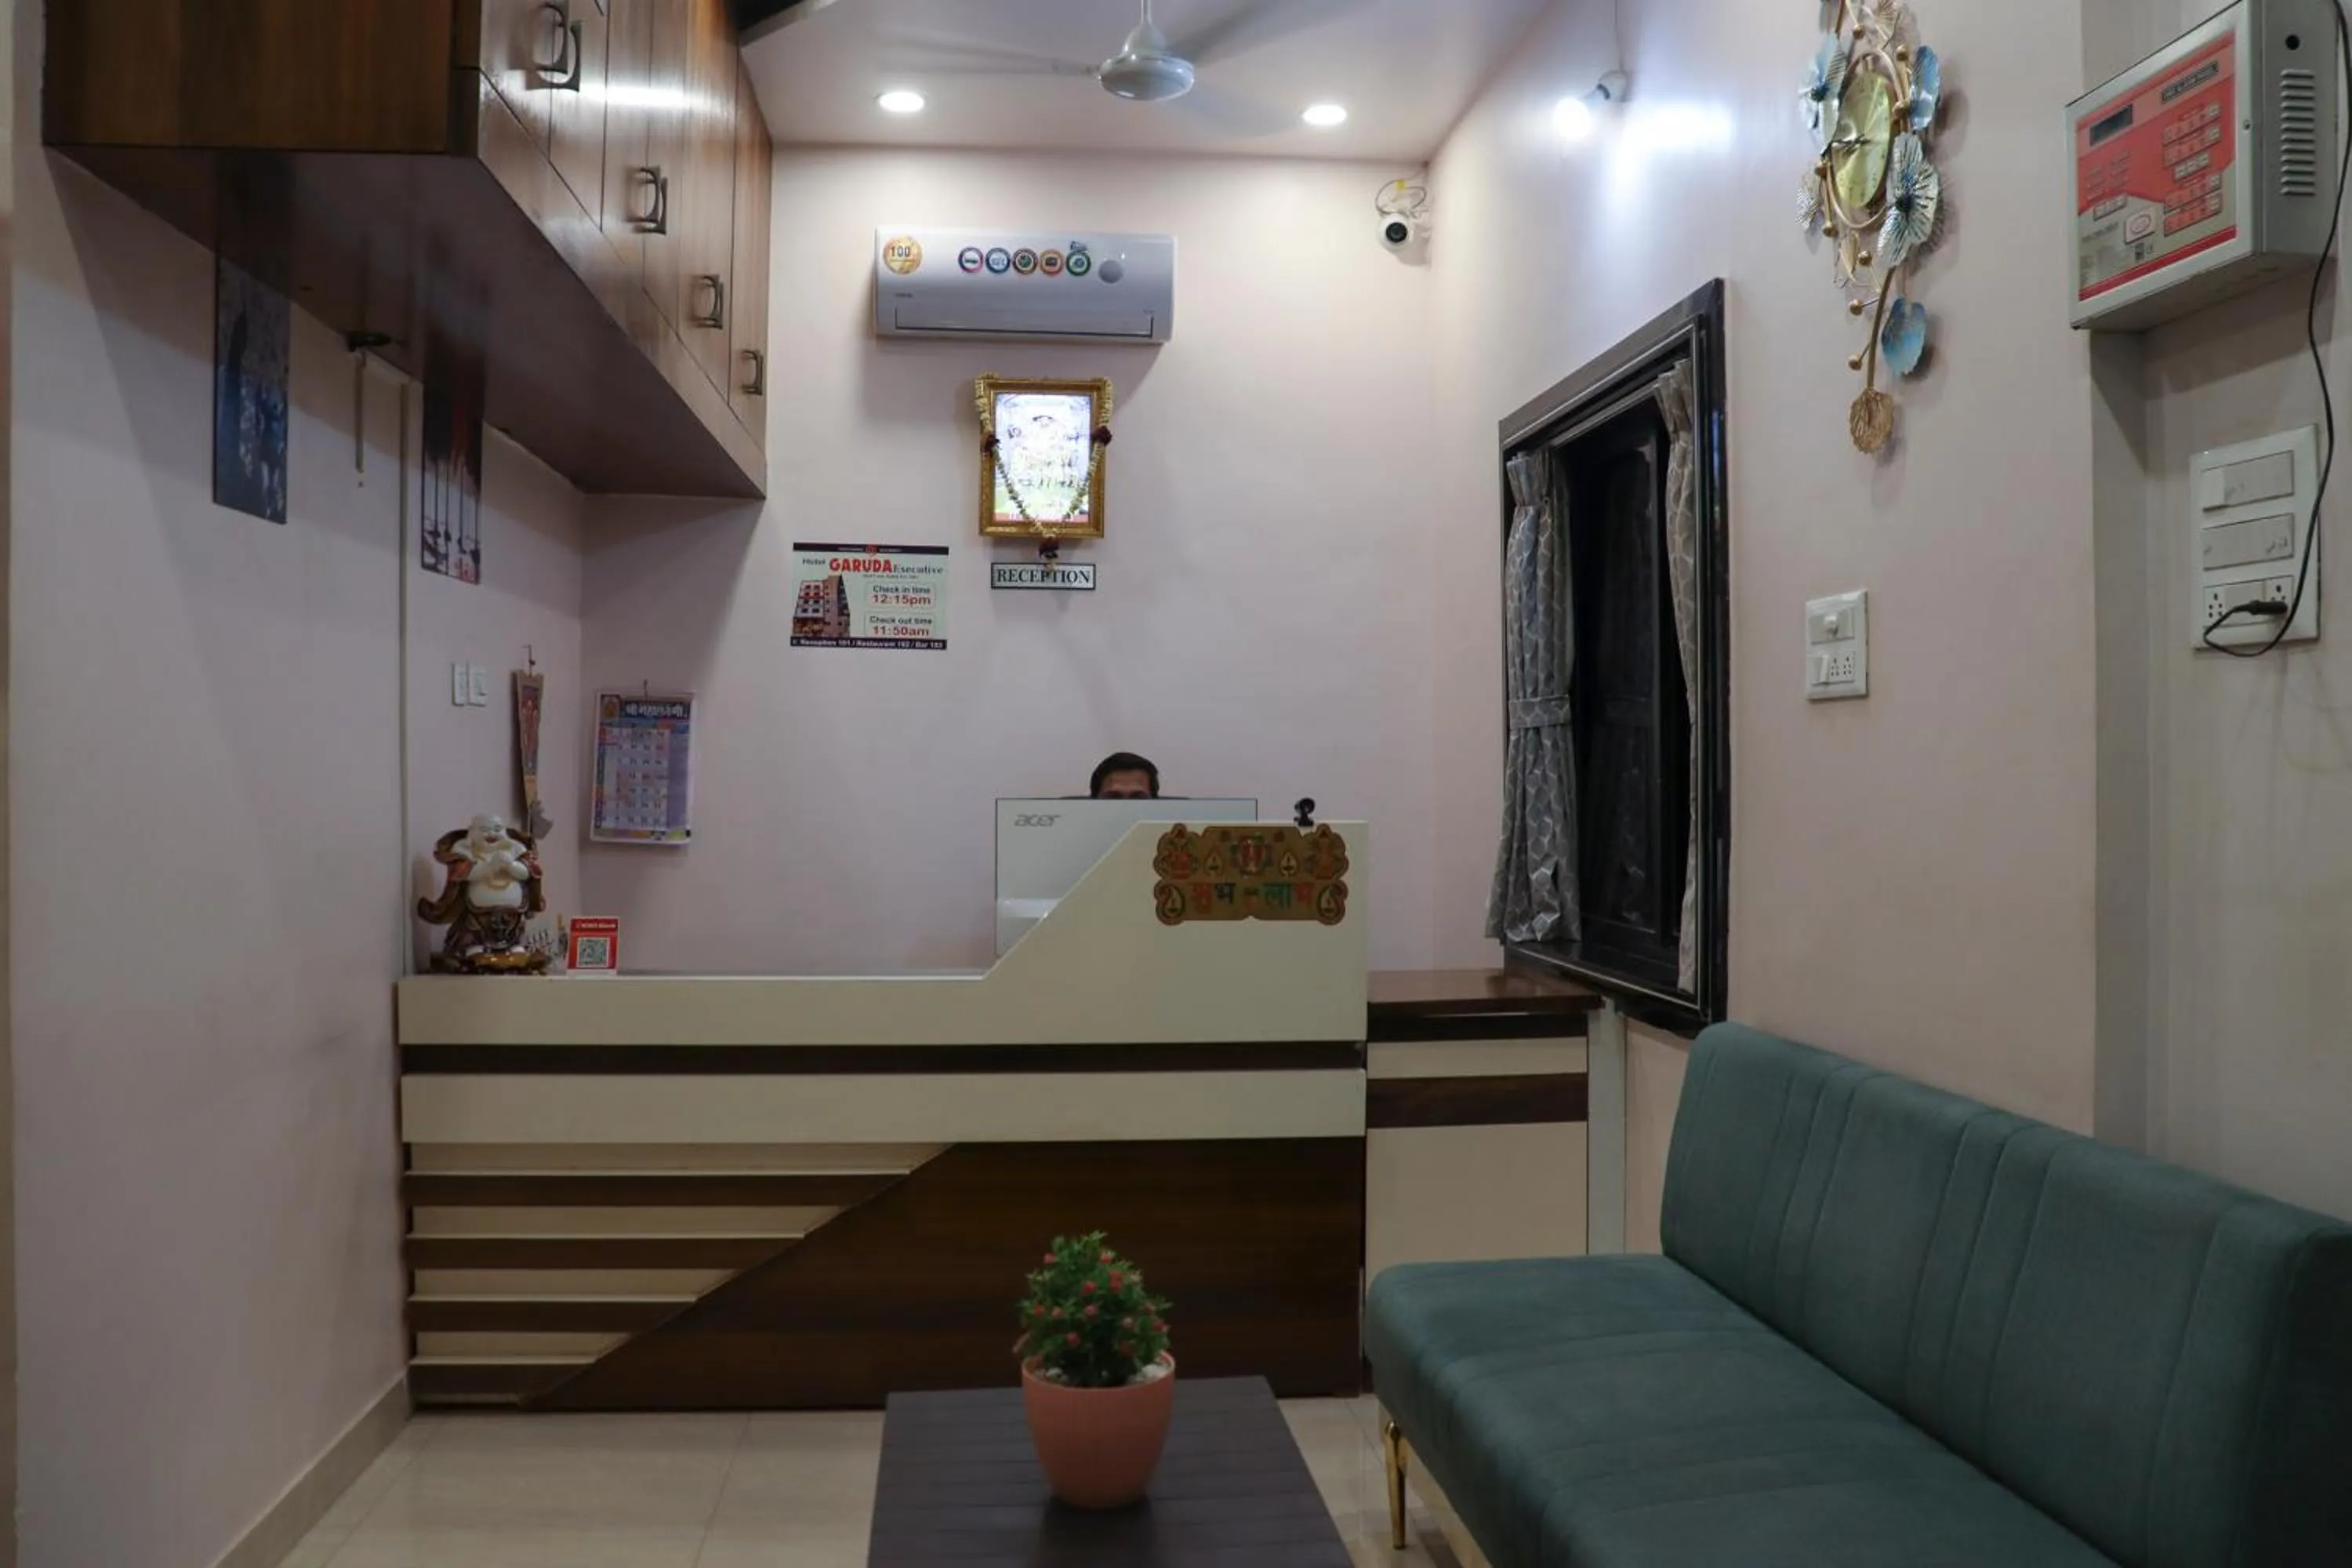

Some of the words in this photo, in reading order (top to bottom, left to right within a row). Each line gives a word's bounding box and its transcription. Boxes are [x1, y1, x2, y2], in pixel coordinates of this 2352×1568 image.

[891, 245, 910, 257] 100
[829, 557, 892, 573] GARUDA
[996, 568, 1091, 583] RECEPTION
[873, 585, 899, 593] Check
[872, 594, 931, 607] 12:15pm
[869, 615, 895, 624] Check
[873, 626, 929, 636] 11:50am
[1014, 813, 1062, 827] acer
